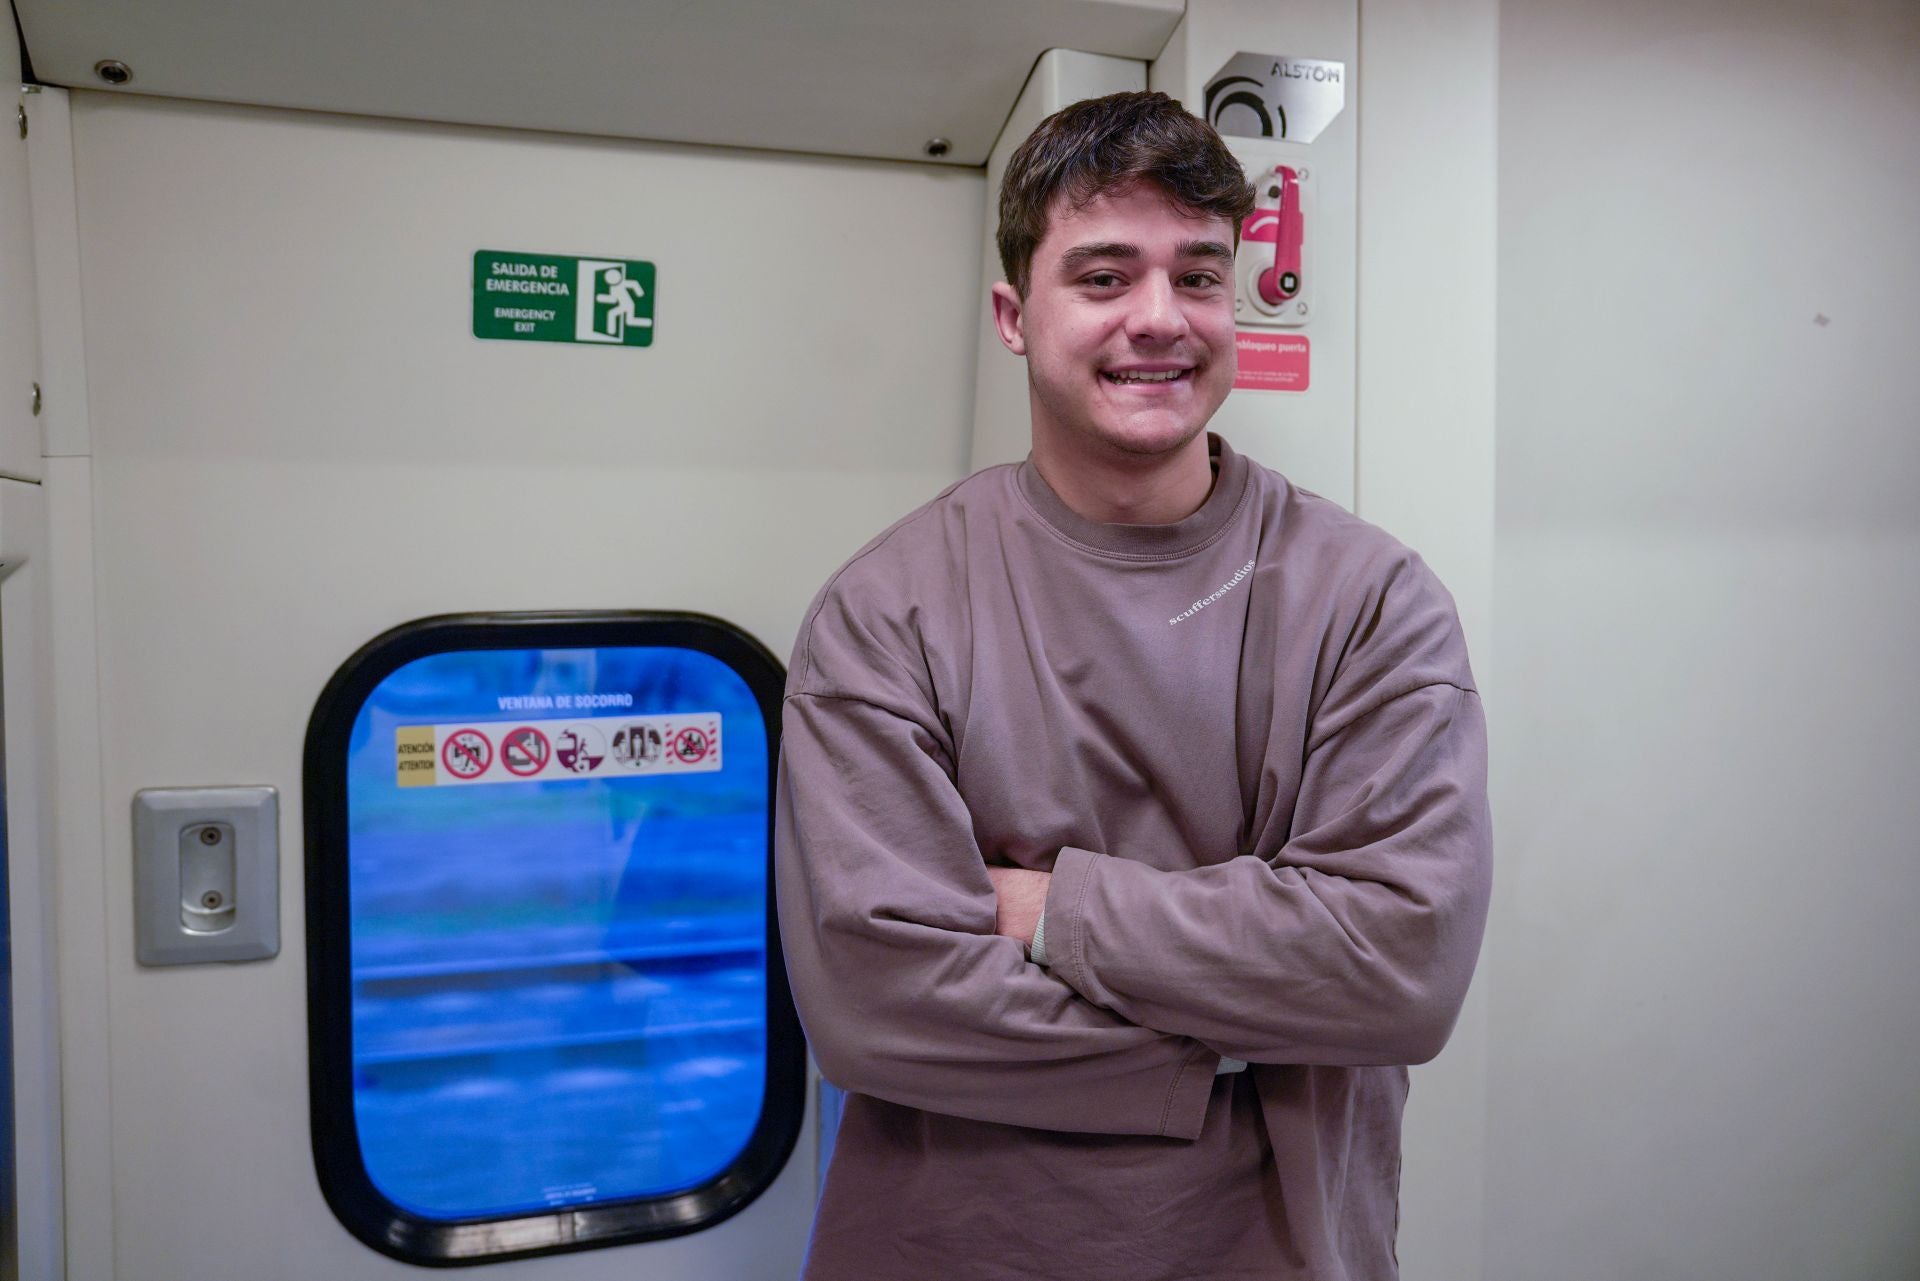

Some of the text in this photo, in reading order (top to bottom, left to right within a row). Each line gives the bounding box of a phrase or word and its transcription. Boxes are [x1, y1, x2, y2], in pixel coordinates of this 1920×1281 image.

[1270, 62, 1340, 83] ALSTOM
[492, 262, 557, 278] SALIDA DE
[486, 279, 569, 295] EMERGENCIA
[495, 307, 555, 320] EMERGENCY
[515, 322, 535, 333] EXIT
[1278, 343, 1306, 353] puerta
[1168, 559, 1256, 626] scuffersstudios
[498, 693, 633, 709] VENTANA DE SOCORRO
[397, 742, 435, 754] ATENCIÓN
[398, 759, 435, 771] ATTENTION
